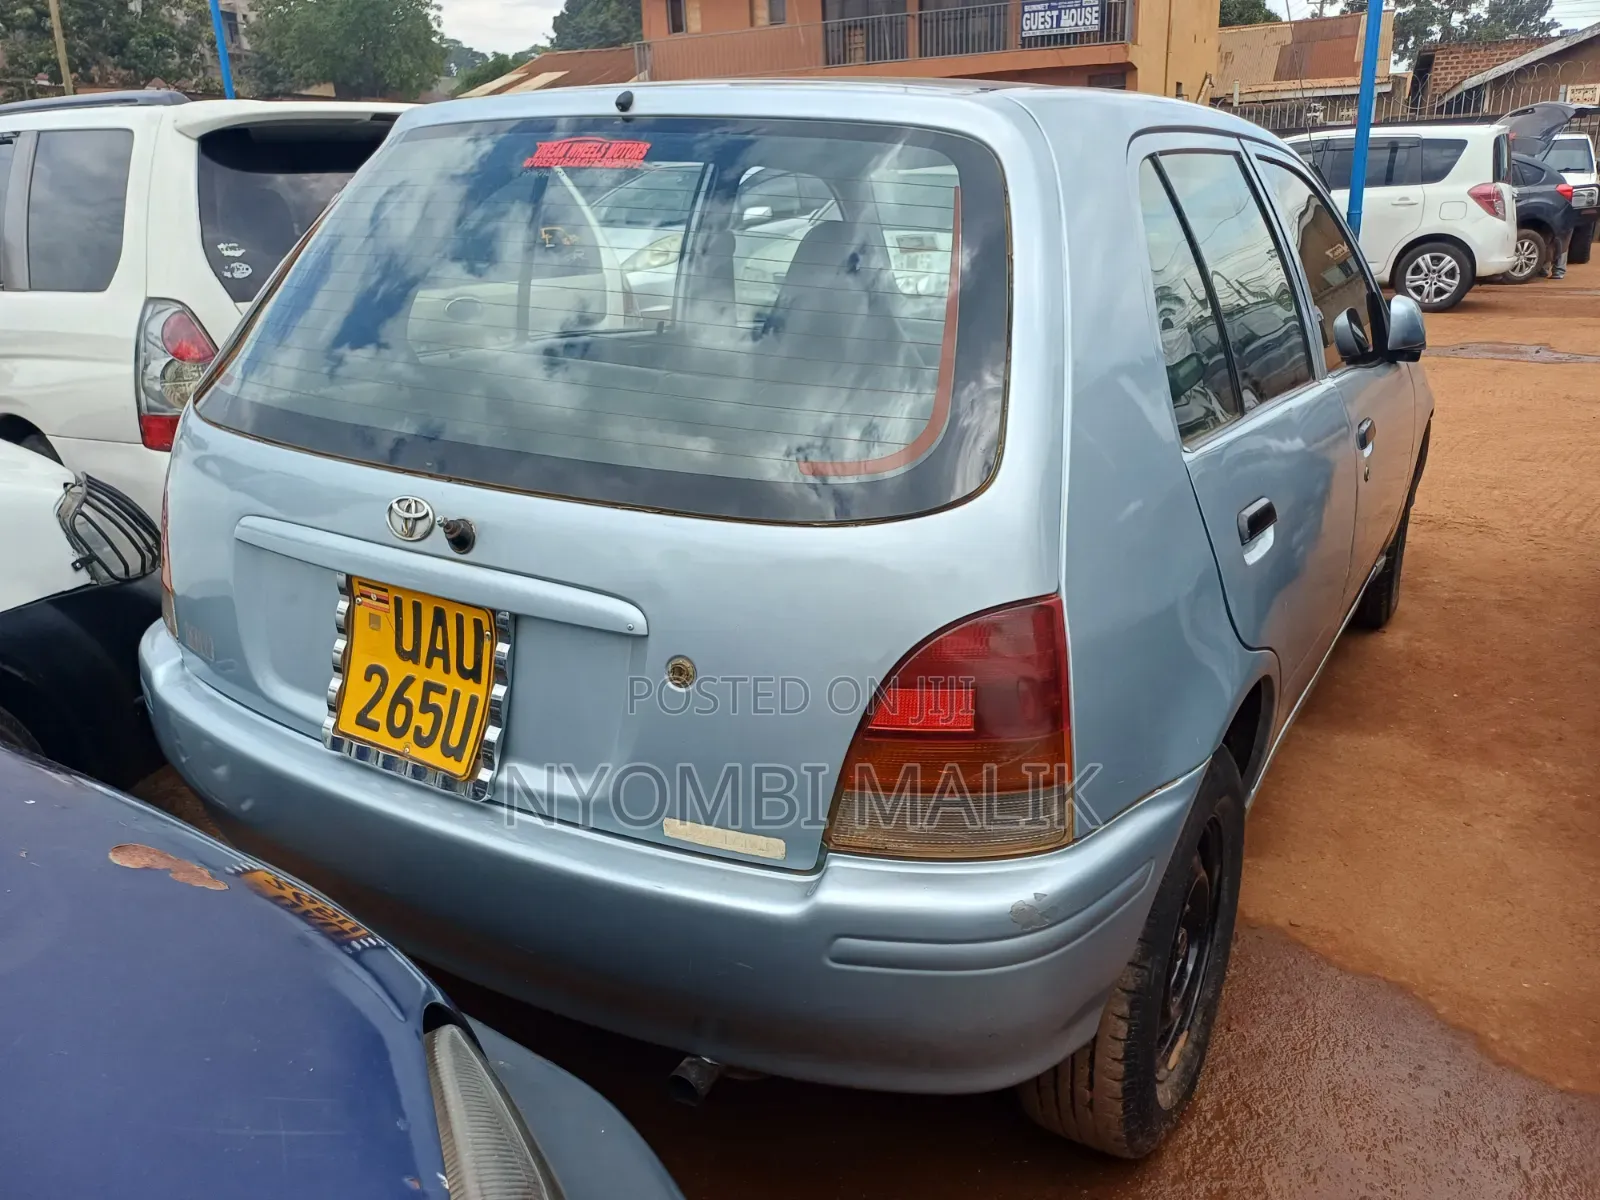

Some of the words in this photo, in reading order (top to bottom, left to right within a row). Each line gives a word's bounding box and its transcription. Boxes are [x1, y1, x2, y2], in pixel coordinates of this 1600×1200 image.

[1022, 10, 1059, 31] GUEST
[1060, 6, 1099, 27] HOUSE
[566, 142, 609, 158] WHEELS
[605, 142, 651, 160] MOTORS
[393, 595, 485, 685] UAU
[354, 663, 479, 763] 265U
